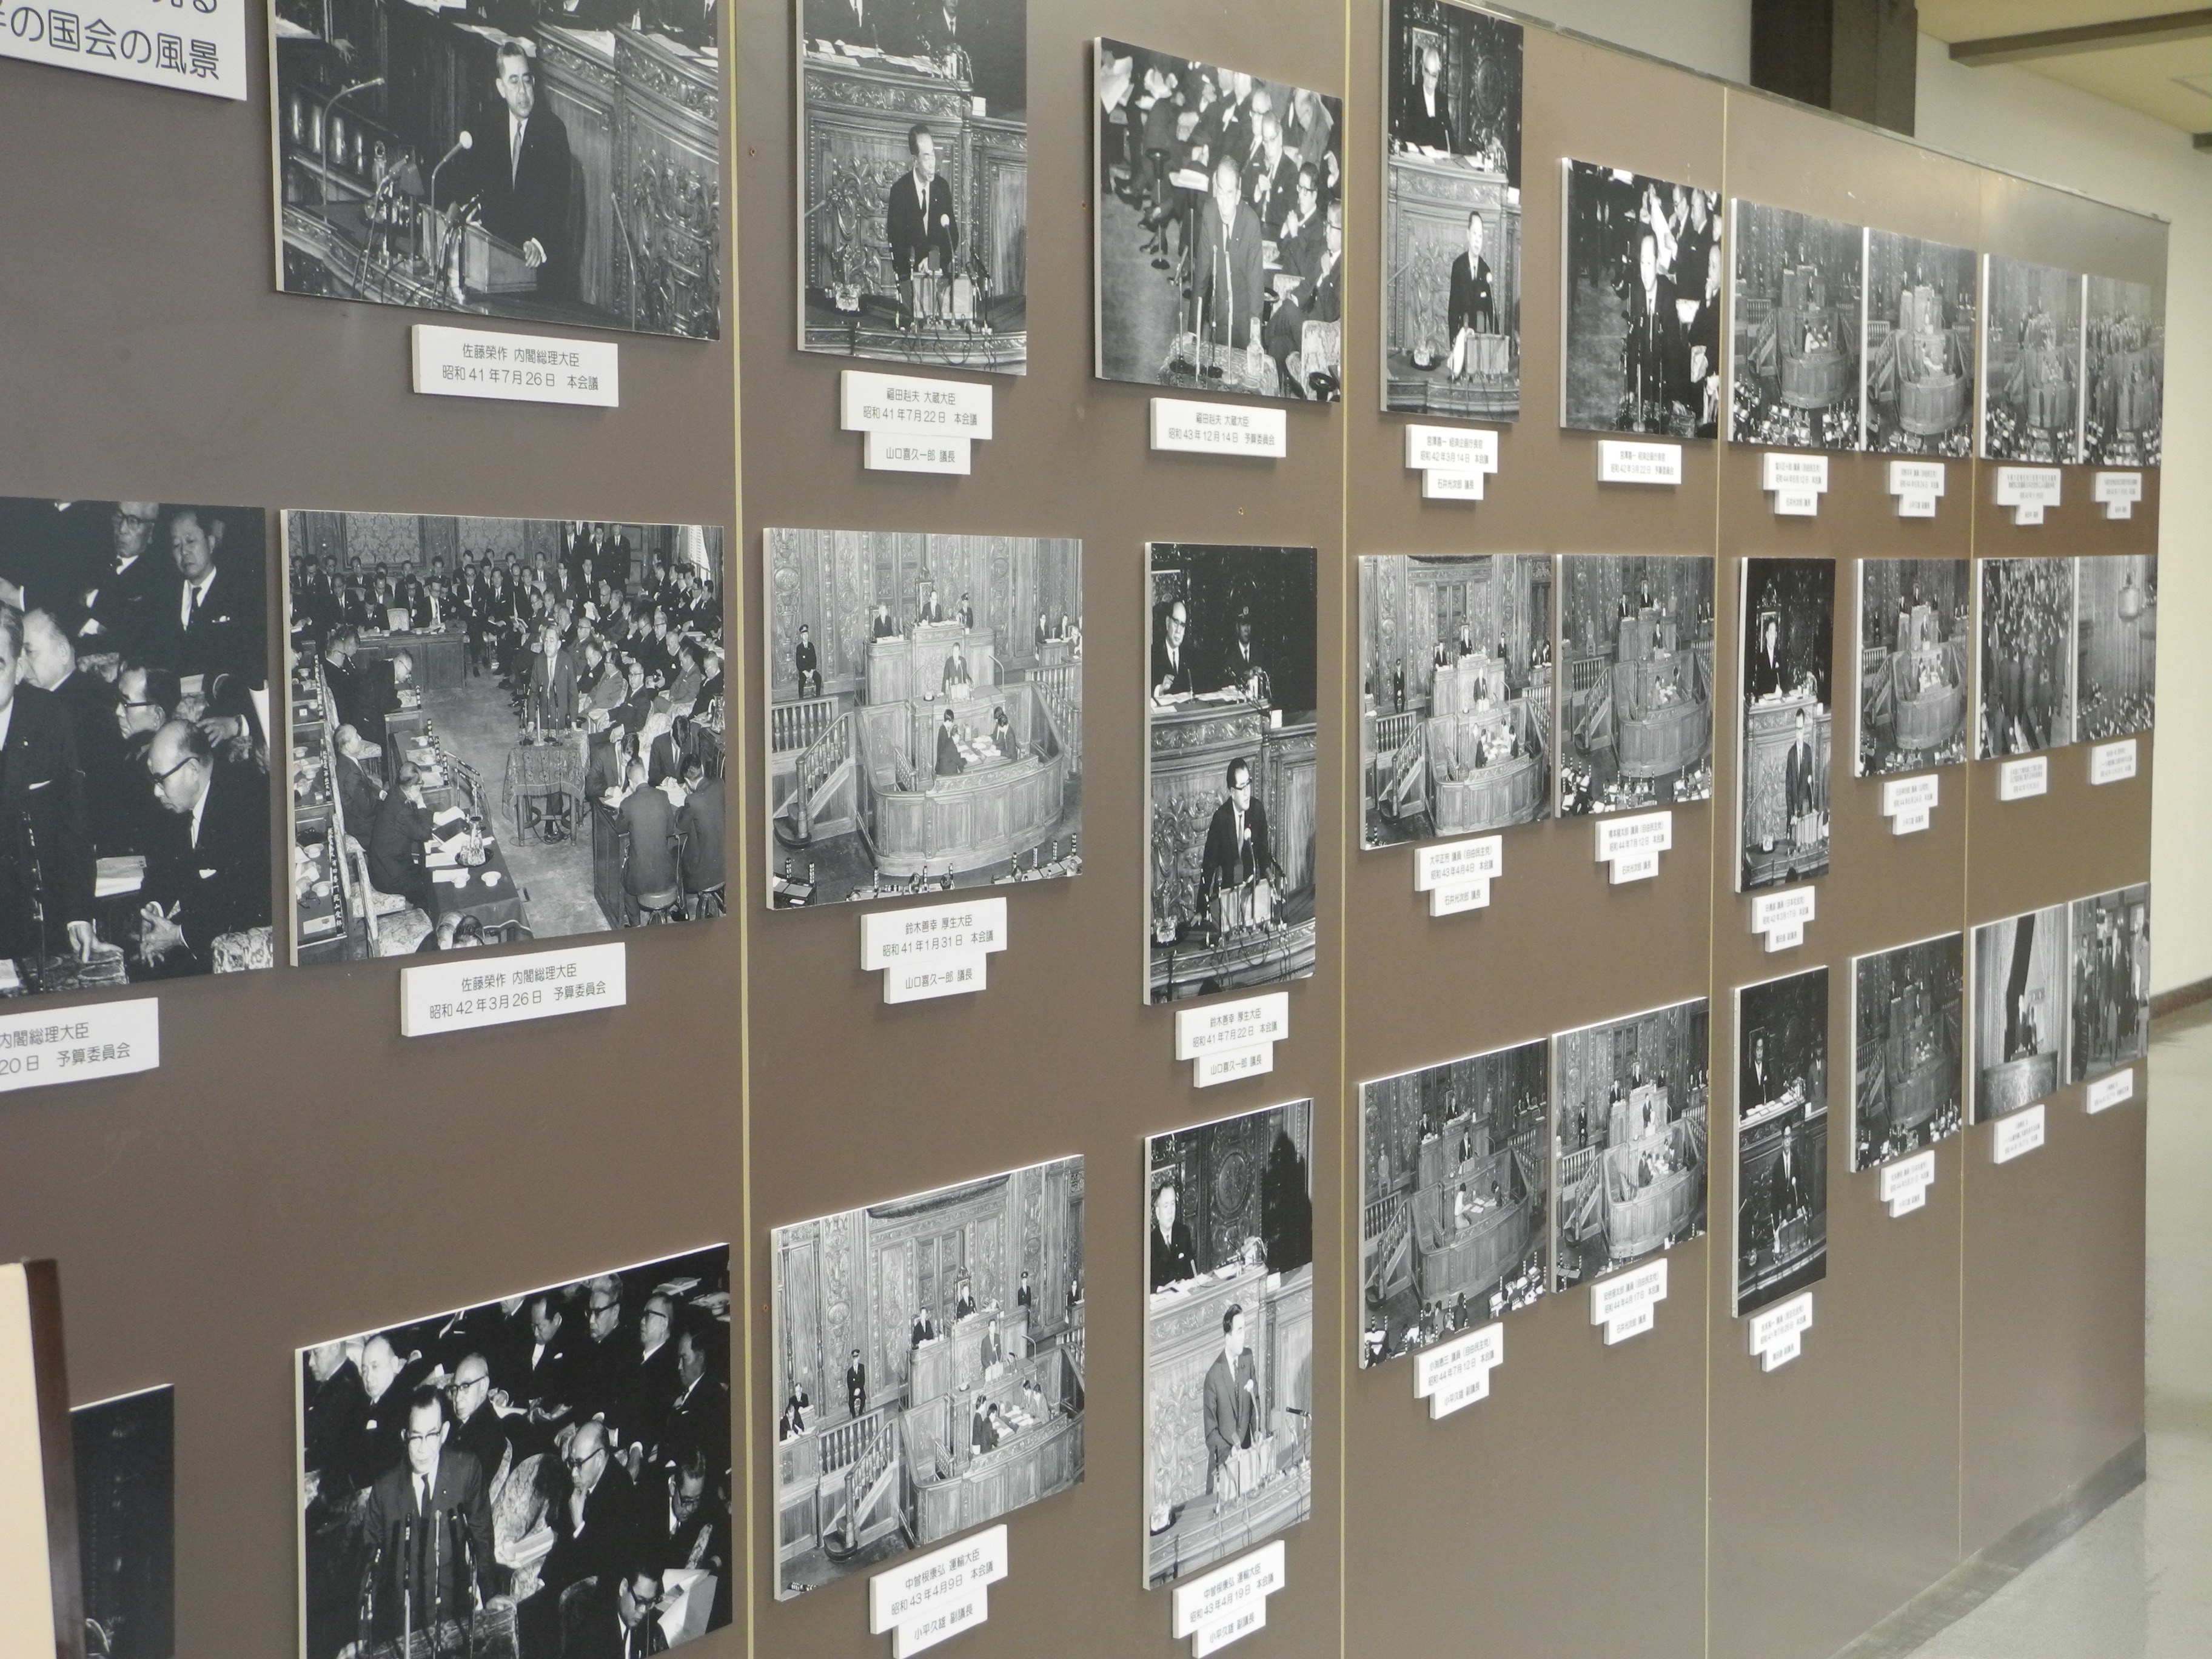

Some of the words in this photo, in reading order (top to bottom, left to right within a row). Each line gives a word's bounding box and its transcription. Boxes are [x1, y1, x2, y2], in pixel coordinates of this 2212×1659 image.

[463, 343, 508, 361] 佐藤榮作
[514, 348, 580, 367] 内閣総理大臣
[567, 374, 599, 391] 本会議
[886, 387, 920, 403] 福田赳夫
[923, 392, 956, 406] 大蔵大臣
[954, 412, 977, 426] 本会議
[886, 446, 936, 462] 山口喜久一郎
[939, 450, 956, 463] 議長
[1475, 454, 1489, 464] 本会議
[1452, 850, 1462, 862] 議員
[1480, 859, 1493, 871] 本会議
[1471, 889, 1481, 900] 議長
[905, 919, 937, 936] 鈴木善幸
[941, 914, 973, 930] 厚生大臣
[971, 929, 993, 943] 本会議
[461, 973, 506, 993] 佐藤榮作
[512, 963, 577, 986] 内閣総理大臣
[905, 970, 954, 990] 山口喜久一郎
[957, 968, 973, 982] 議長
[554, 980, 606, 1002] 予算委員会
[1210, 1013, 1235, 1028] 鈴木善幸
[1237, 1008, 1262, 1023] 厚生大臣
[1260, 1021, 1278, 1034] 本会議
[0, 1022, 90, 1049] 内閣総理大臣
[56, 1042, 131, 1067] 予算委員会
[1250, 1054, 1262, 1067] 議長
[1480, 1349, 1495, 1364] 本会議
[949, 1548, 980, 1572] 運輸大臣
[971, 1560, 993, 1580] 本会議
[1237, 1562, 1262, 1584] 運輸大臣
[1256, 1572, 1274, 1590] 本会議
[914, 1616, 946, 1641] 小平久雄
[950, 1603, 974, 1624] 副議長
[1236, 1611, 1255, 1631] 副議長
